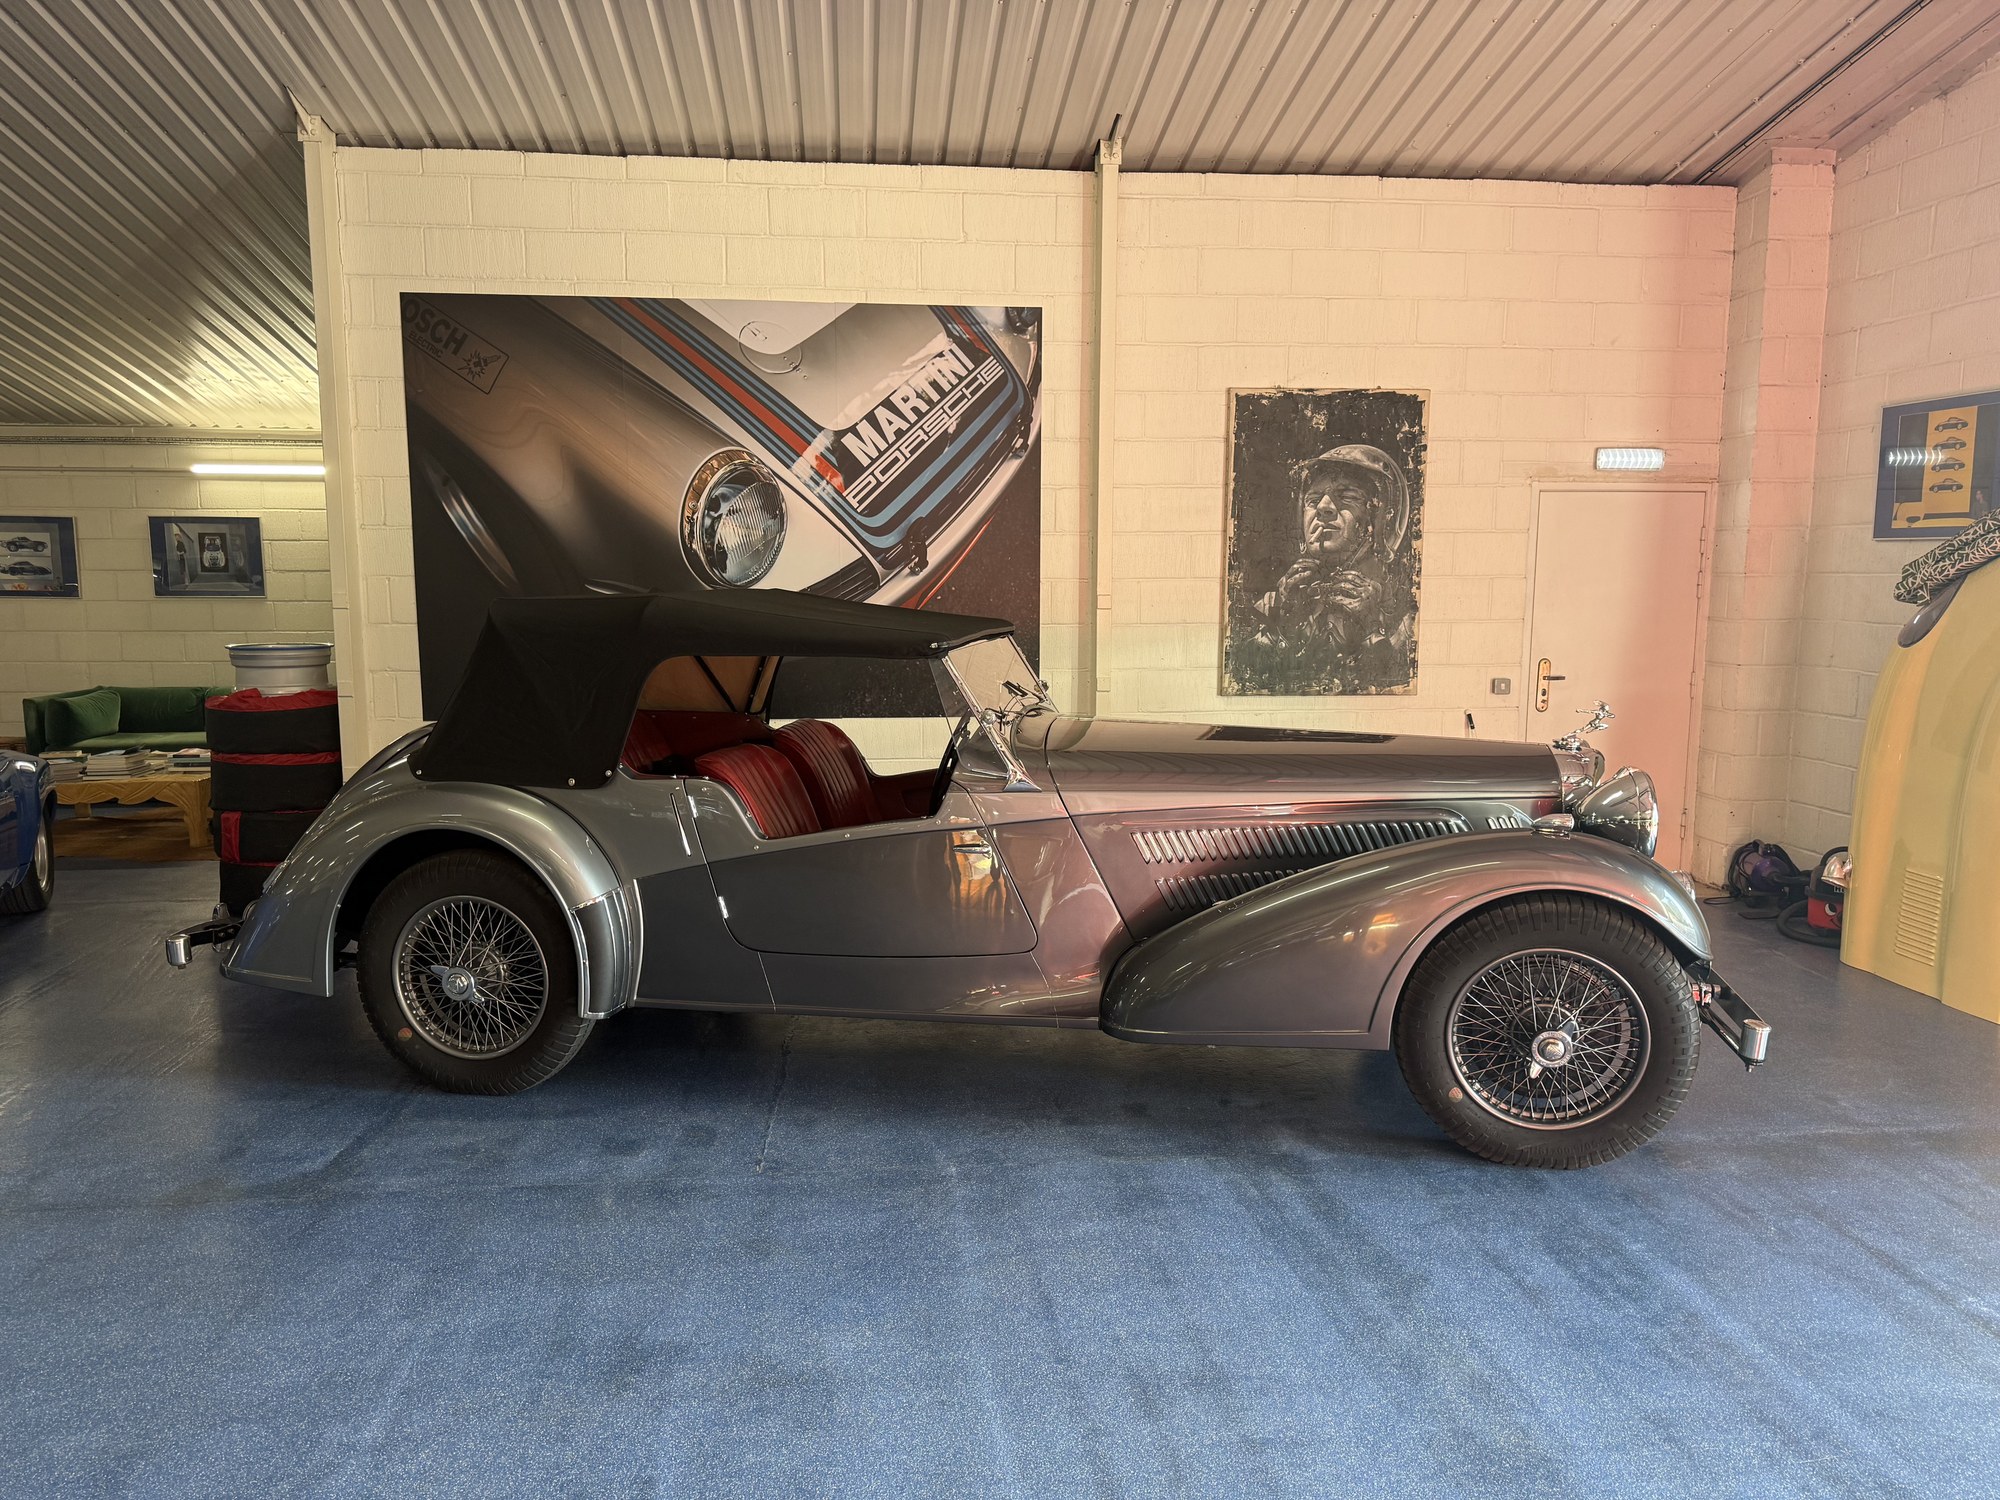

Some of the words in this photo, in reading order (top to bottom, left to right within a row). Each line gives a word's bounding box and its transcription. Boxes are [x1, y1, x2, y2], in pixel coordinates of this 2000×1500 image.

[408, 330, 443, 358] ELECTRIC
[840, 342, 975, 468] MARTINI
[845, 358, 1003, 509] PORSCHE
